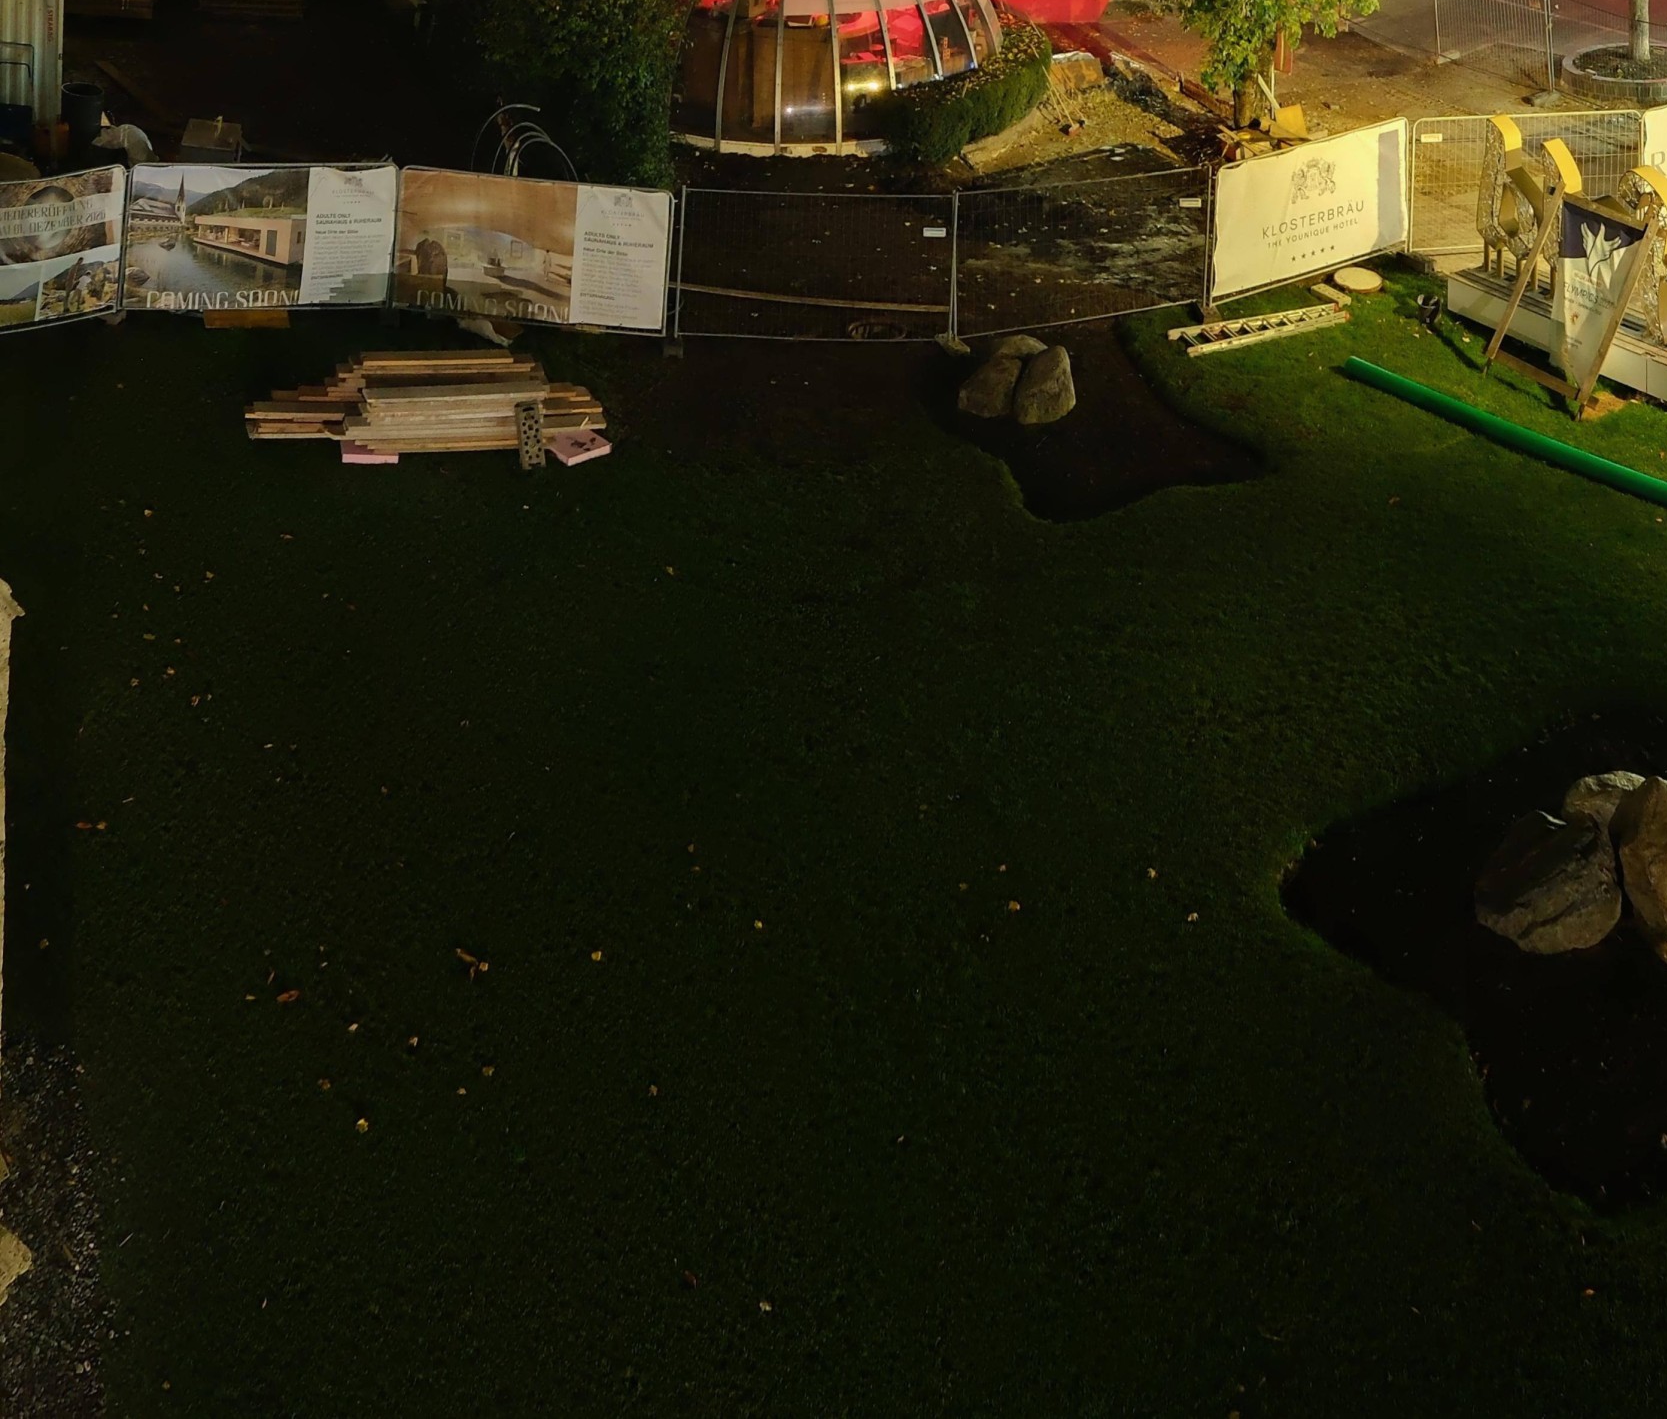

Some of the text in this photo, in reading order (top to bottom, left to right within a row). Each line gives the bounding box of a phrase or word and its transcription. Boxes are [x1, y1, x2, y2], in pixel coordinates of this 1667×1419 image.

[0, 200, 93, 222] IEDERERÖFFNUNG
[1262, 199, 1365, 240] KLOSTERBRÄU
[1267, 218, 1359, 249] THE YOUNIQUE HOTEL
[146, 290, 229, 310] COMING
[416, 289, 498, 316] COMING
